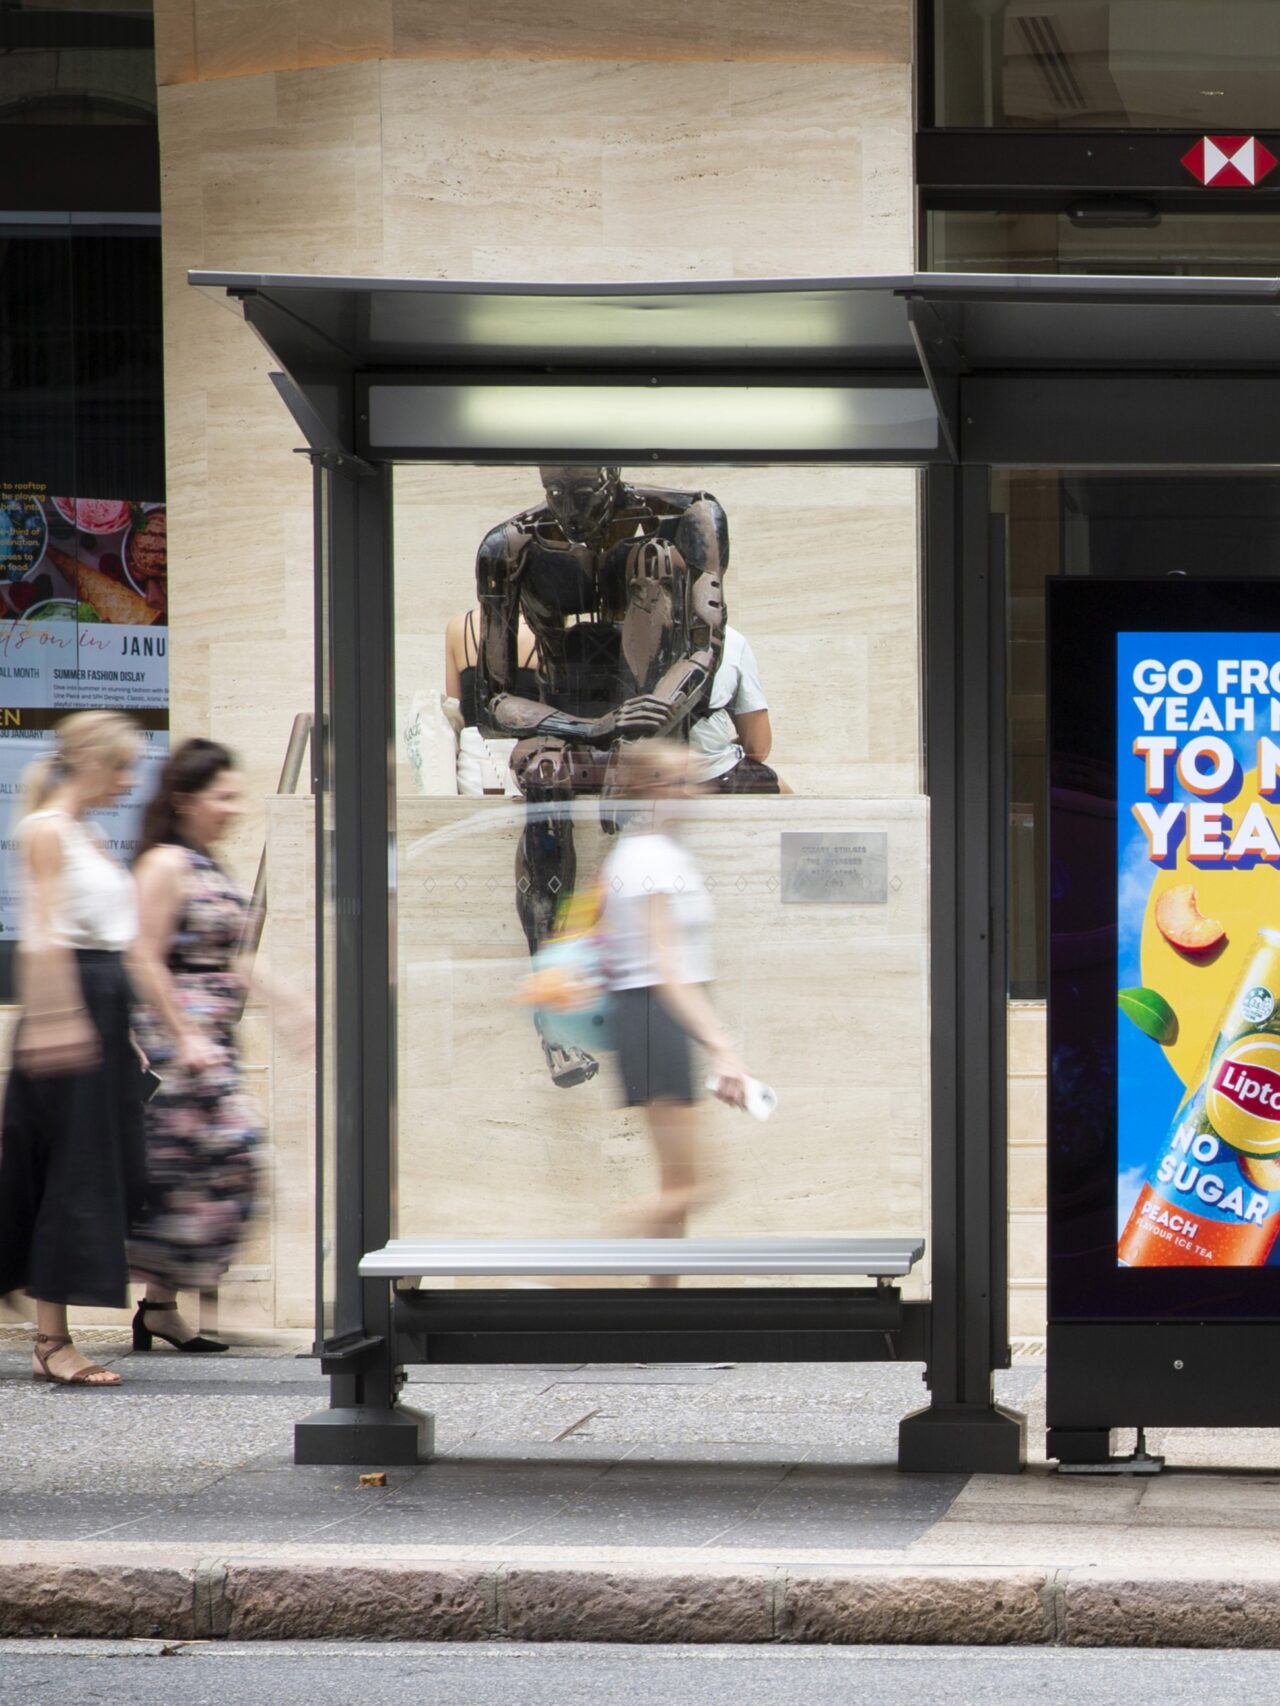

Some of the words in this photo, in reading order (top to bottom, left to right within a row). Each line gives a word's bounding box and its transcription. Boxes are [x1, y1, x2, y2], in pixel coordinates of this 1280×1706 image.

[14, 481, 46, 491] rooftop
[121, 636, 167, 657] JANU
[13, 667, 40, 679] MONTH
[53, 668, 85, 680] SUMMER
[87, 670, 118, 682] FASHION
[119, 671, 146, 682] DISLAY
[1132, 659, 1203, 695] GO
[1132, 697, 1255, 732] YEAH
[1133, 735, 1240, 800] TO
[1171, 1122, 1221, 1164] NO
[1156, 1156, 1271, 1227] SUGAR
[1140, 1200, 1199, 1240] PEACH
[1174, 1236, 1194, 1251] ICE
[1194, 1245, 1214, 1260] TEA
